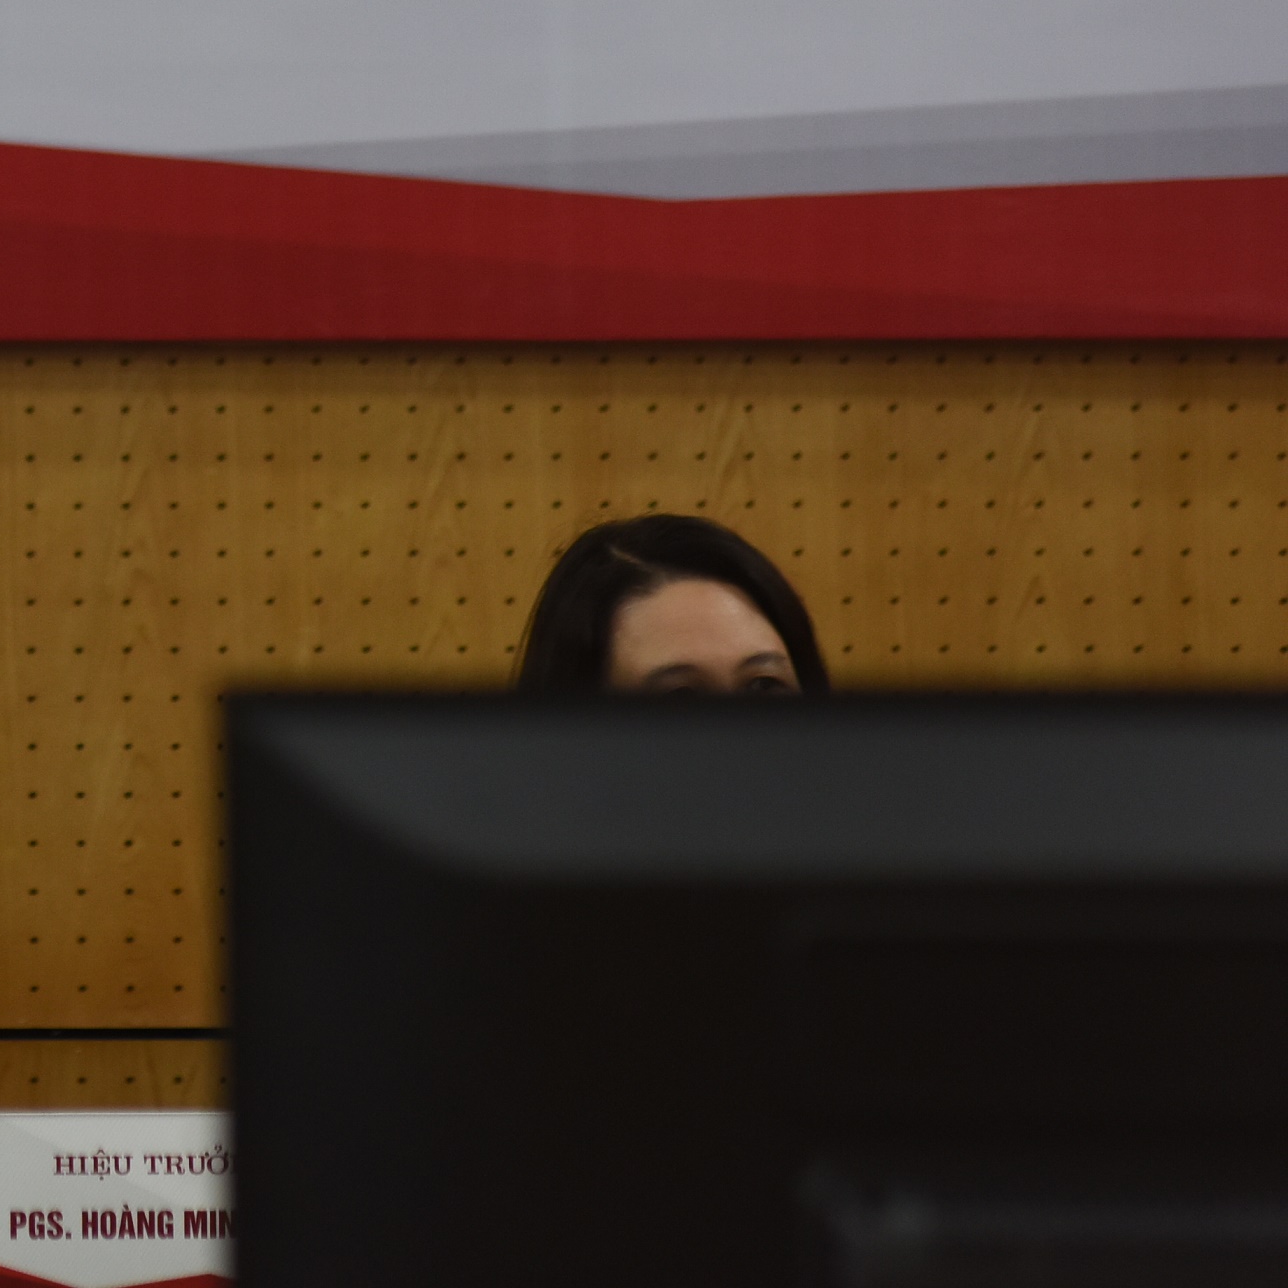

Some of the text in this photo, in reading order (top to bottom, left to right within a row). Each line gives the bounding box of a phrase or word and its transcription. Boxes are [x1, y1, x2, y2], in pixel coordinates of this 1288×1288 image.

[52, 1144, 234, 1181] HIỆU TRƯỞ
[9, 1209, 72, 1240] PGS.
[81, 1204, 174, 1240] HOÀNG
